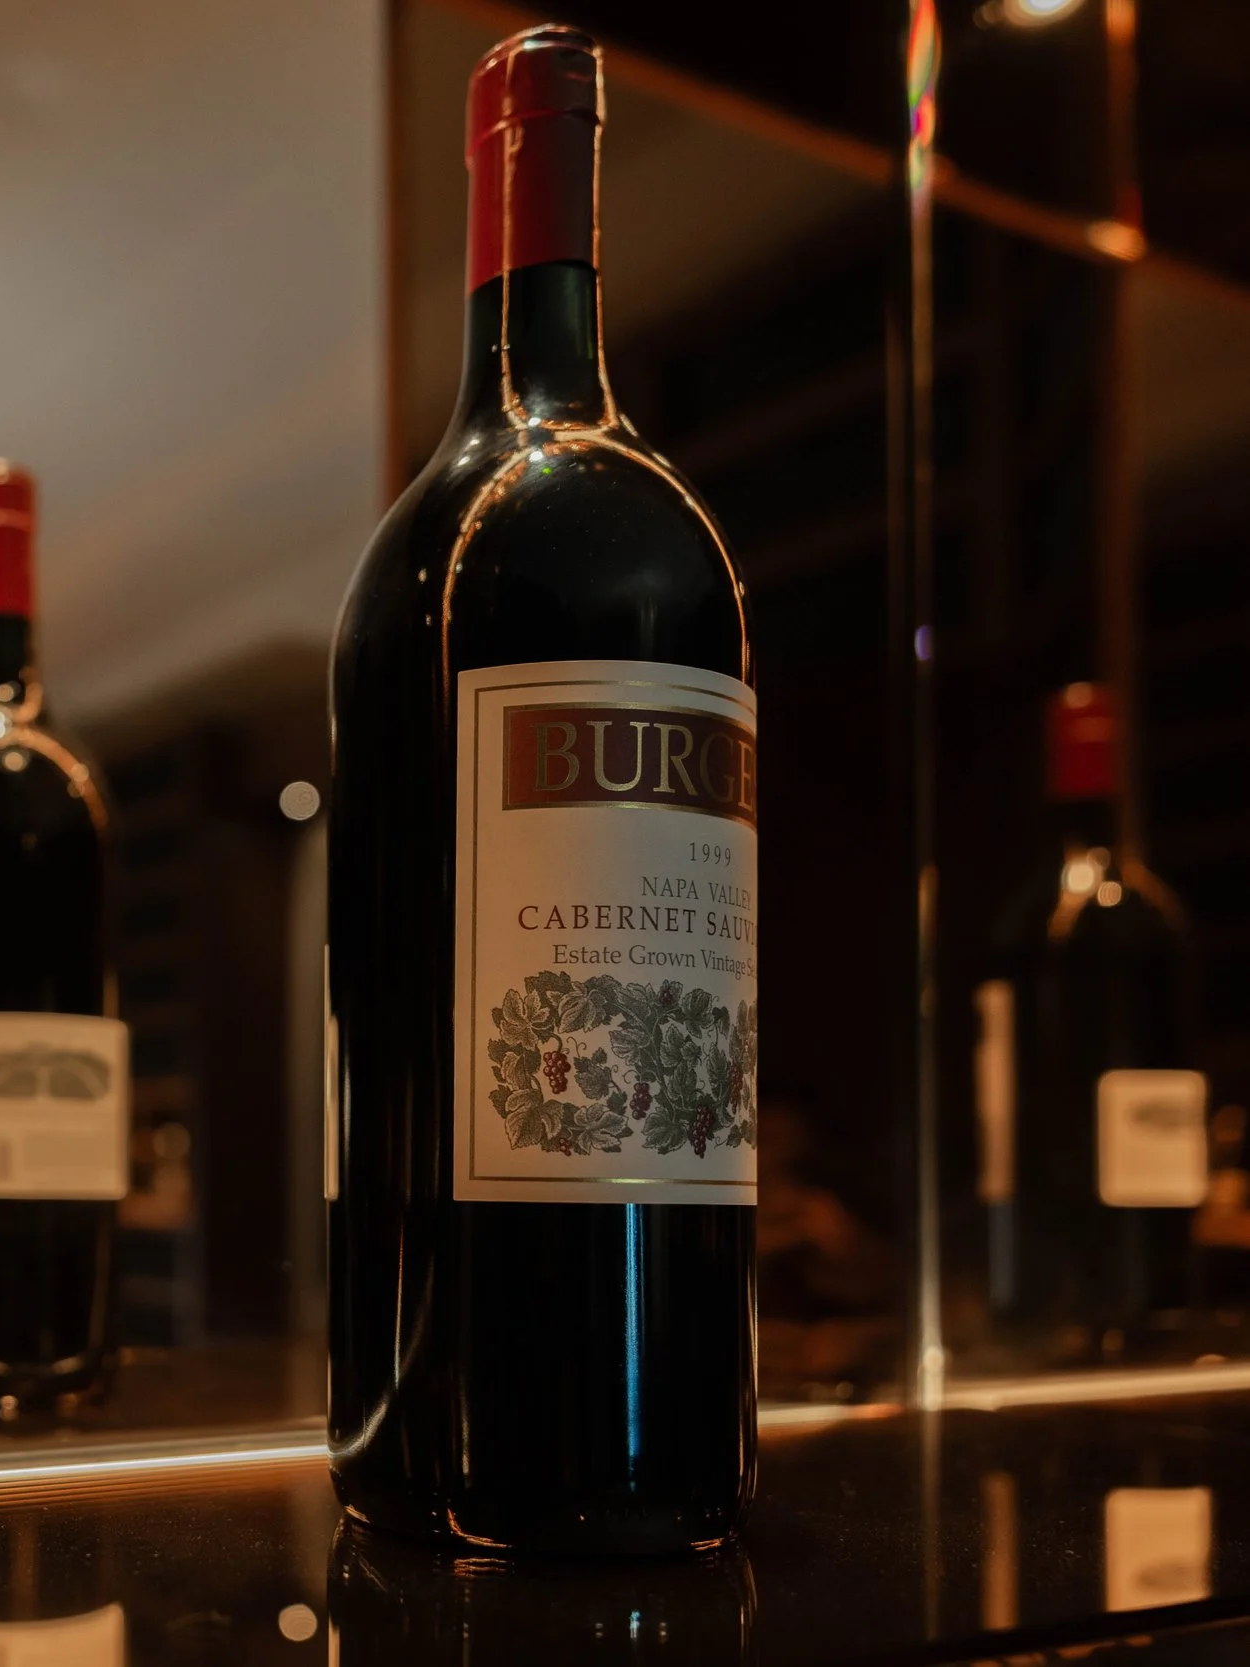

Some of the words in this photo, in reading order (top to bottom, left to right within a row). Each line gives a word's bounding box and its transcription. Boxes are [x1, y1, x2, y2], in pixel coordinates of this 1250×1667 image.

[689, 841, 731, 866] 1999
[641, 876, 699, 900] NAPA
[518, 904, 696, 933] CABERNET
[707, 911, 757, 948] SAUVI
[553, 944, 622, 965] Estate
[629, 944, 696, 968] Grown
[700, 949, 746, 981] Vintage
